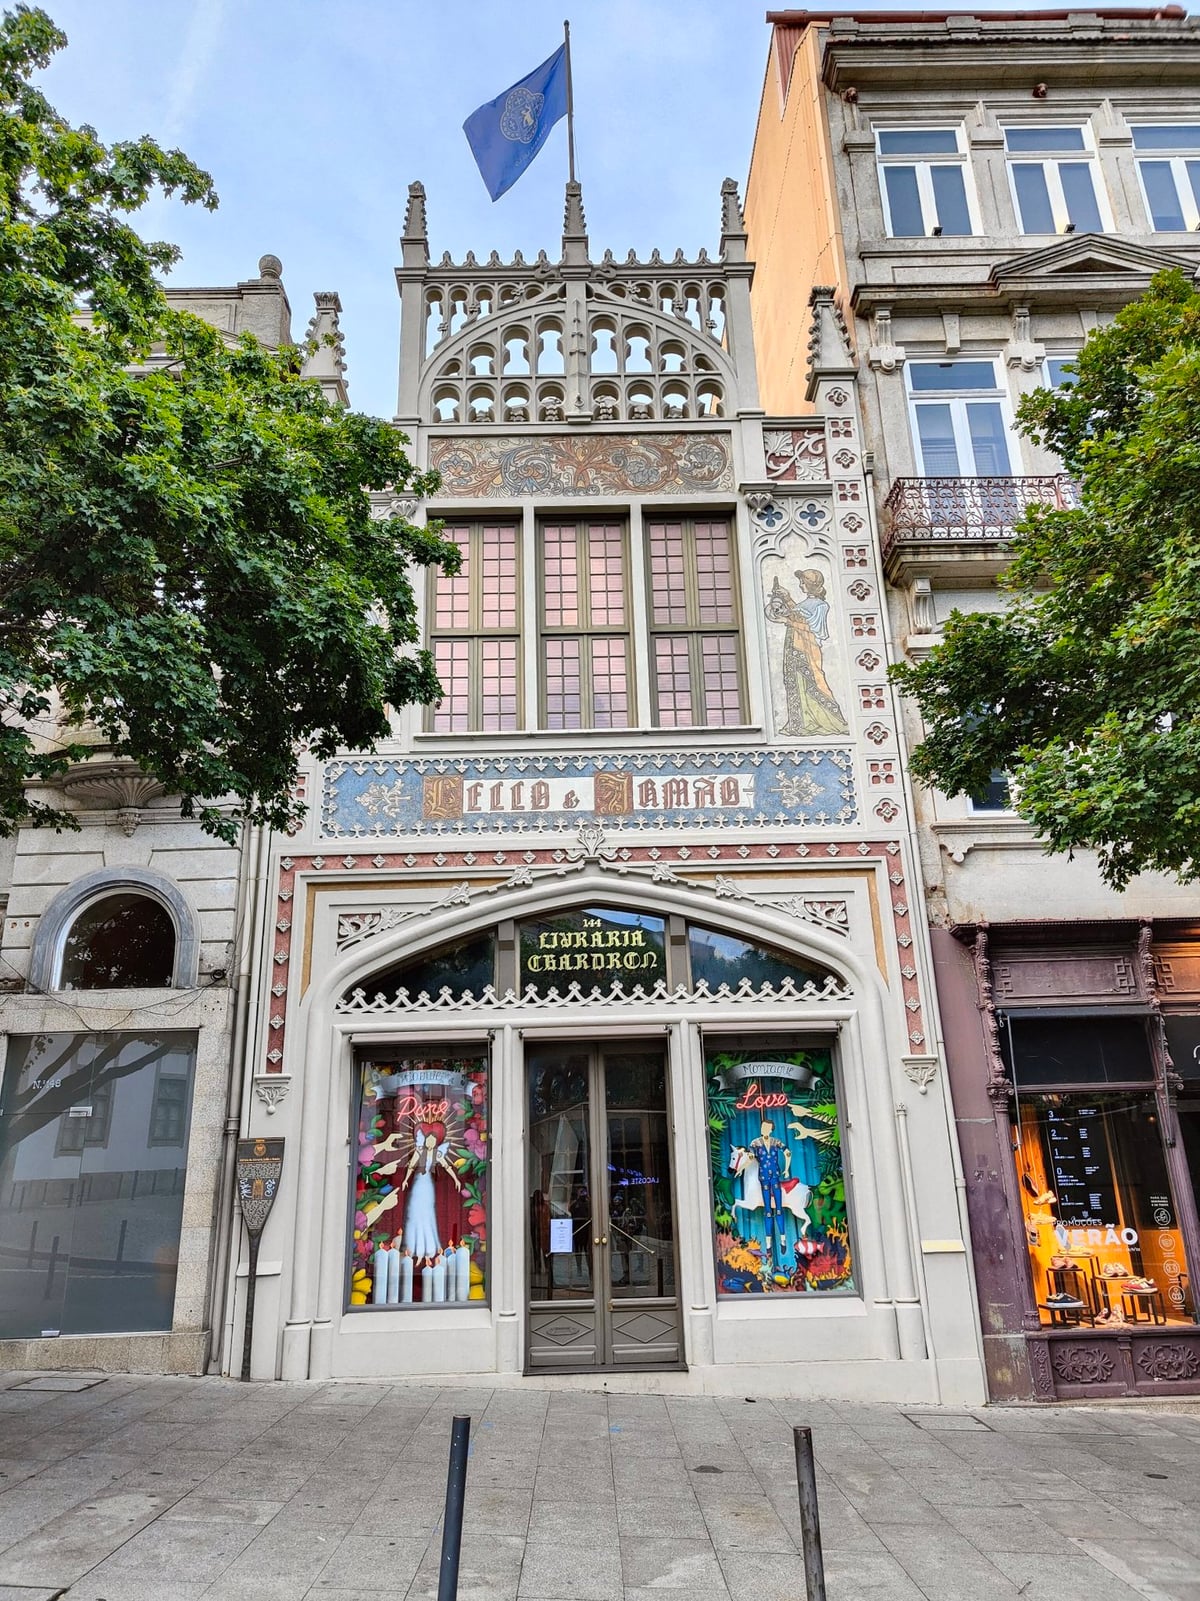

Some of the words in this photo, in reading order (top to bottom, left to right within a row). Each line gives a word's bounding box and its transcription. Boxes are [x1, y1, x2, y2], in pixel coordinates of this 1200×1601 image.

[424, 775, 551, 819] LELLO
[562, 789, 580, 810] &
[582, 918, 602, 928] 144
[538, 929, 647, 949] LIVRARIA
[527, 951, 658, 973] CHARDRON
[736, 1083, 789, 1109] Love
[396, 1096, 449, 1122] Pure
[1048, 1110, 1054, 1118] 3
[1051, 1129, 1057, 1137] 2
[1054, 1148, 1059, 1156] 1
[1054, 1223, 1139, 1248] VERÃO
